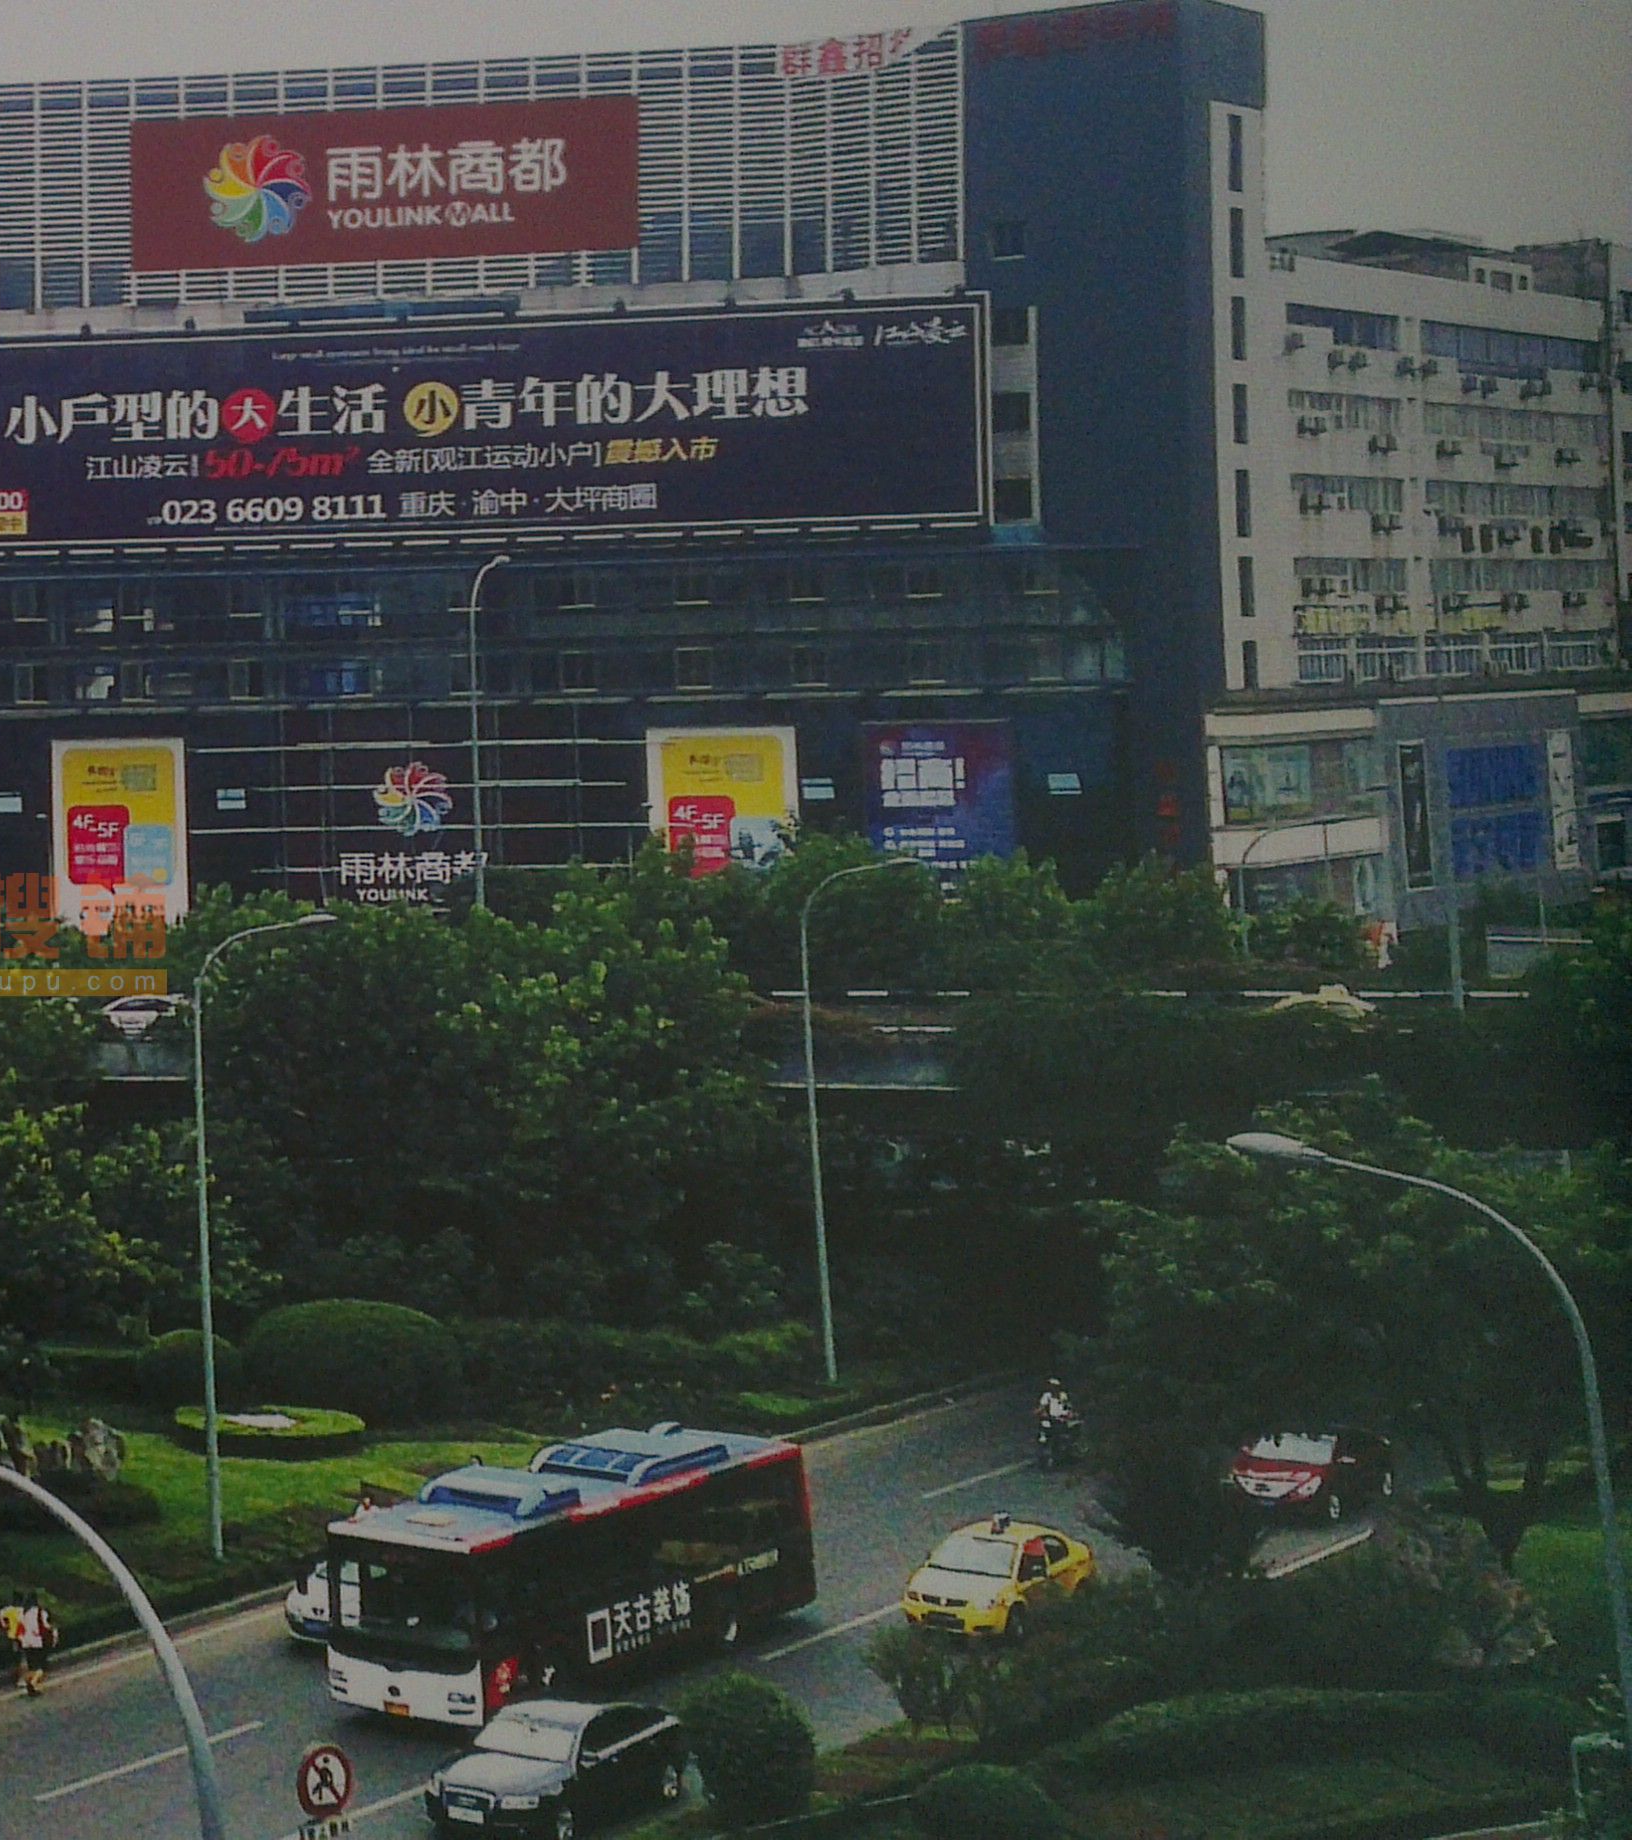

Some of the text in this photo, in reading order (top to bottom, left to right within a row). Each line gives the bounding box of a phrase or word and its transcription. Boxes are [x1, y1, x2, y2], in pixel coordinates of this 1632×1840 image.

[325, 137, 567, 202] 雨林商都
[327, 204, 442, 229] YOULINK
[85, 454, 190, 481] 江山凌云
[161, 498, 218, 525] 023
[225, 494, 304, 524] 6609
[311, 493, 387, 520] 8111
